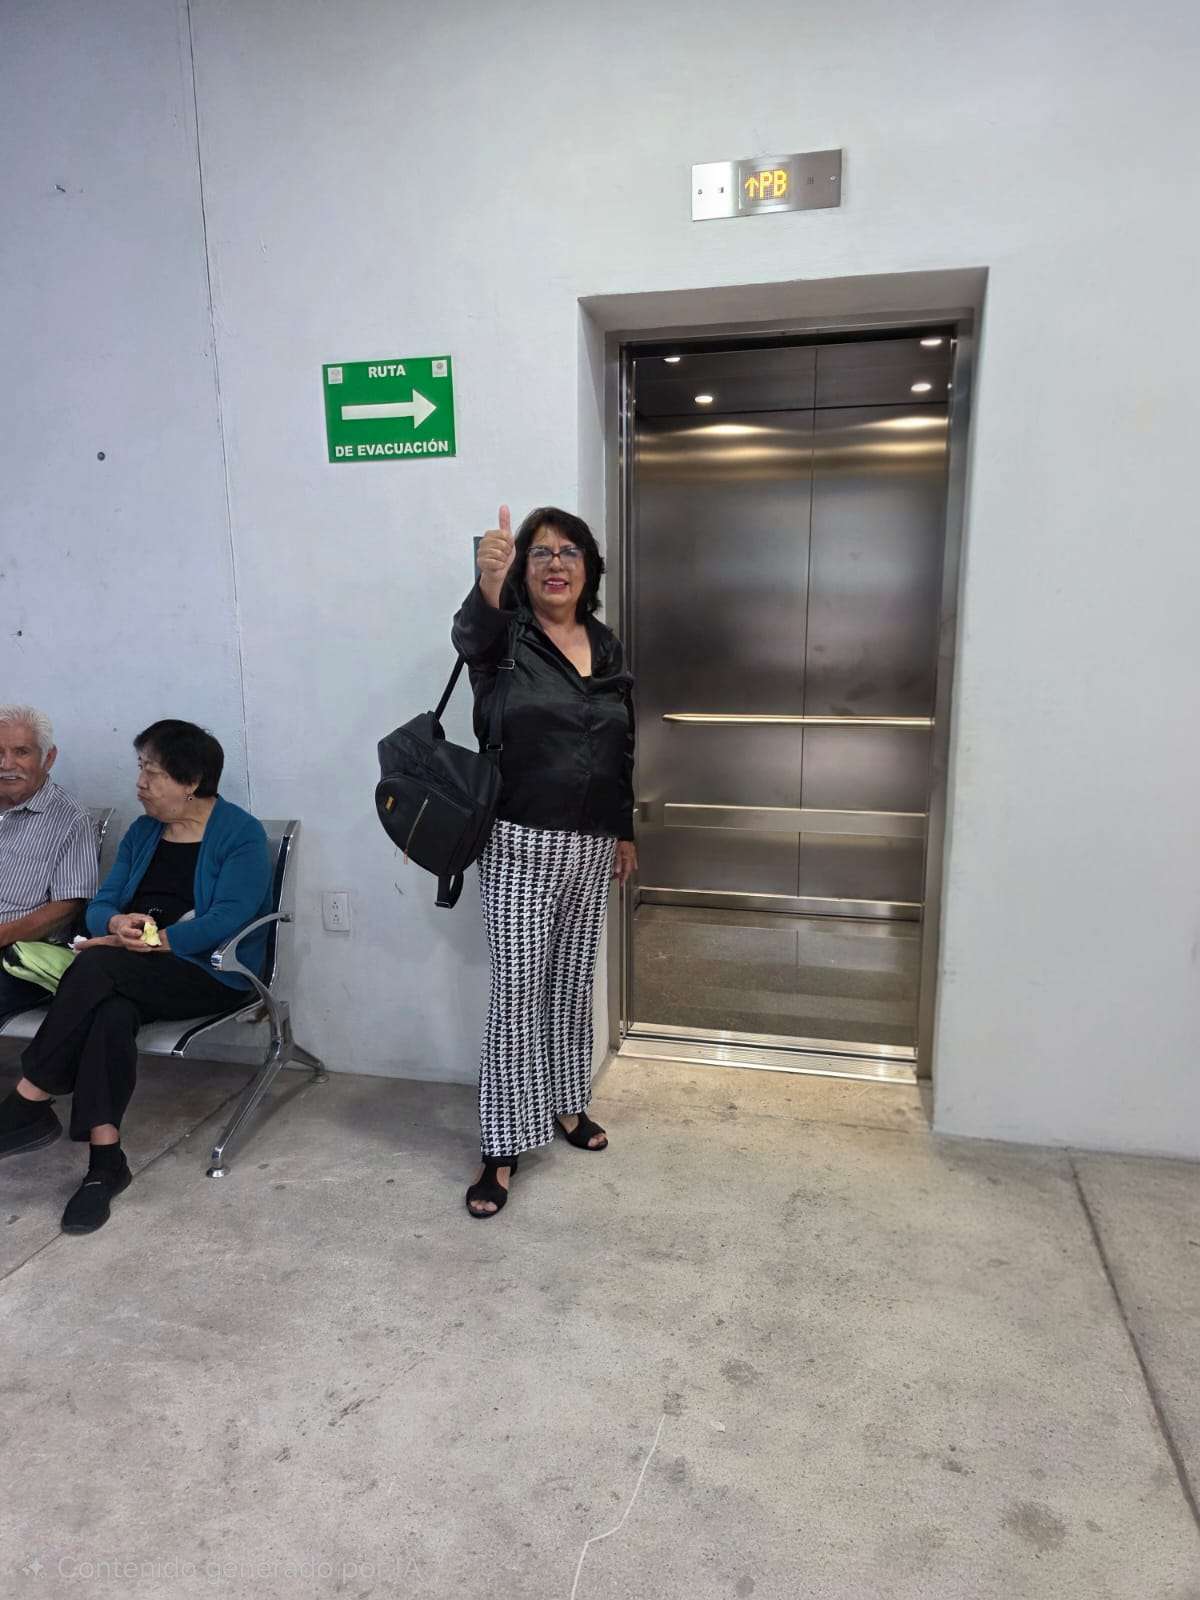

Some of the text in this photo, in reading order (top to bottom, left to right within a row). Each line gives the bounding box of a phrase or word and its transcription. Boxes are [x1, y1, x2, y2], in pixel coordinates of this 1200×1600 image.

[759, 168, 788, 198] PB
[368, 364, 406, 378] RUTA
[335, 438, 449, 457] DE EVACUACIÓN
